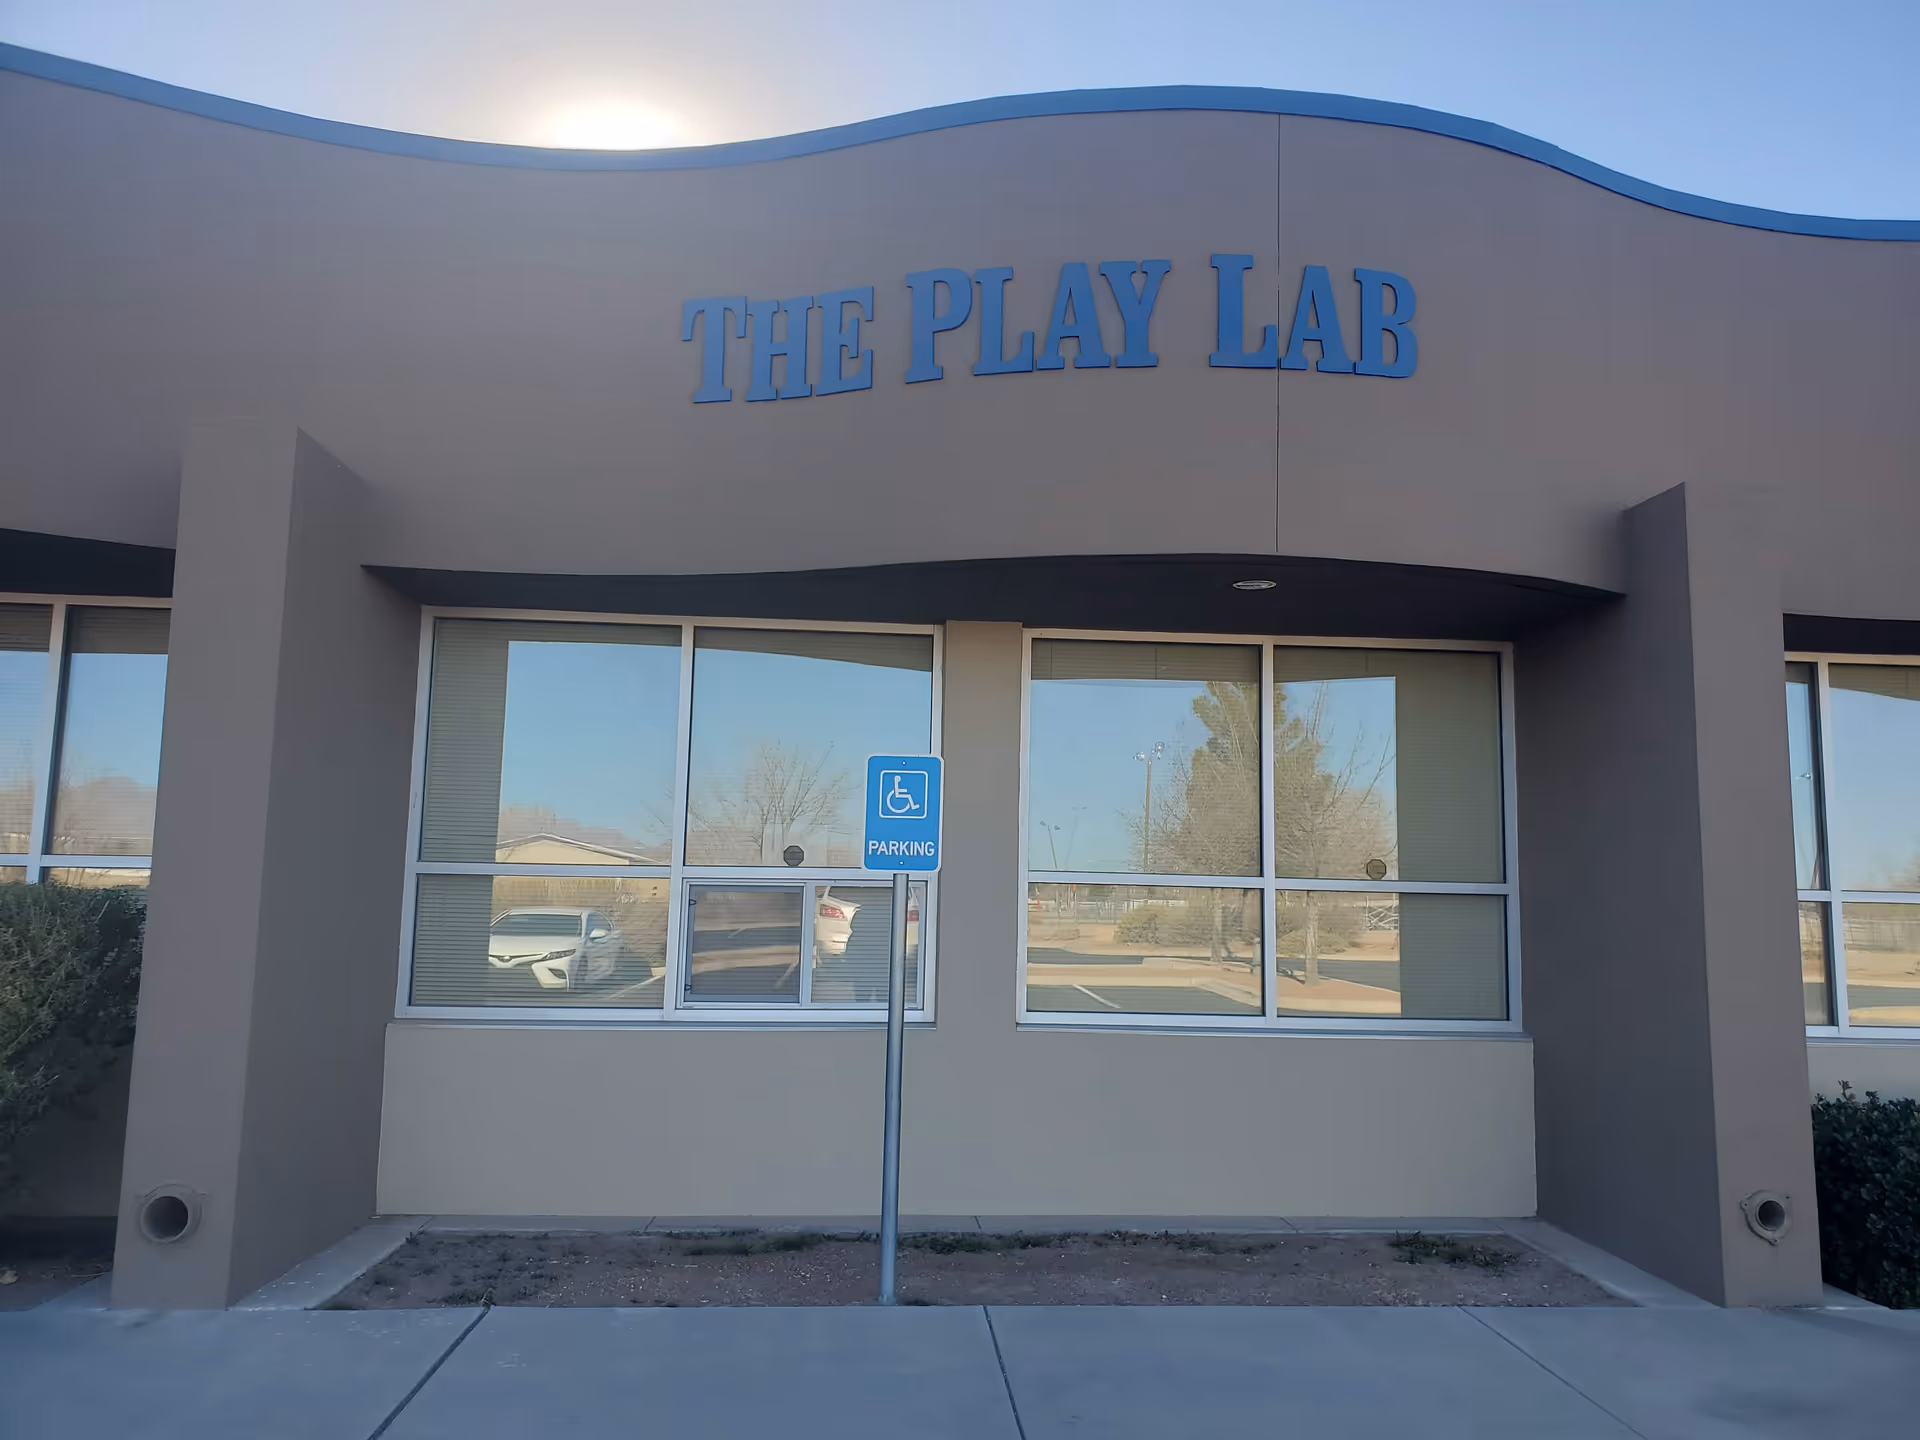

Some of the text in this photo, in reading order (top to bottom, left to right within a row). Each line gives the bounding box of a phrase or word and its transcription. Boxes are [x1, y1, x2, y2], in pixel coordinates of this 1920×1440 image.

[682, 253, 1419, 403] THE PLAY LAB
[868, 840, 935, 857] PARKING
